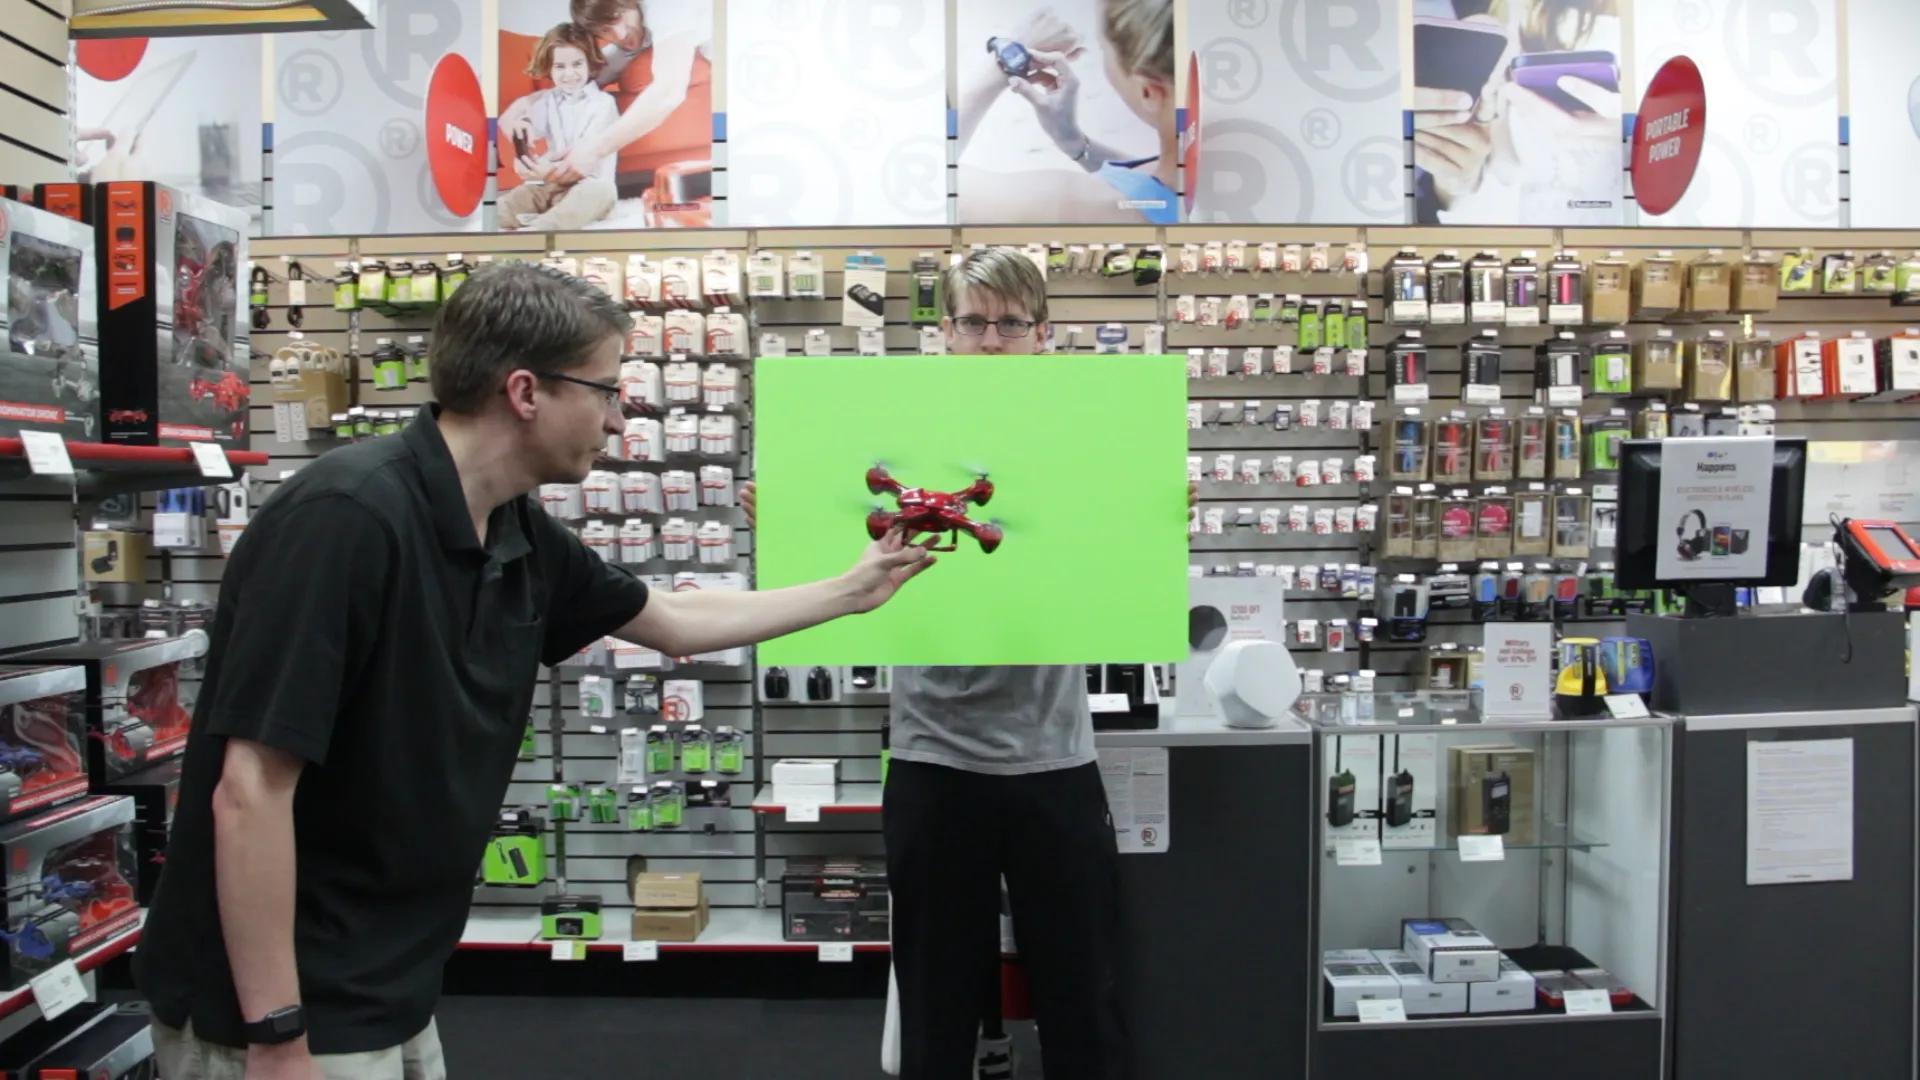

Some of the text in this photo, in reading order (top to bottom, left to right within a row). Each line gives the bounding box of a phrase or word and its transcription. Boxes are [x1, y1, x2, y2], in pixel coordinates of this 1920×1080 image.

[445, 123, 473, 154] POWER
[1645, 108, 1690, 141] PORTABLE
[1648, 136, 1681, 164] POWER
[1697, 462, 1737, 473] Happens
